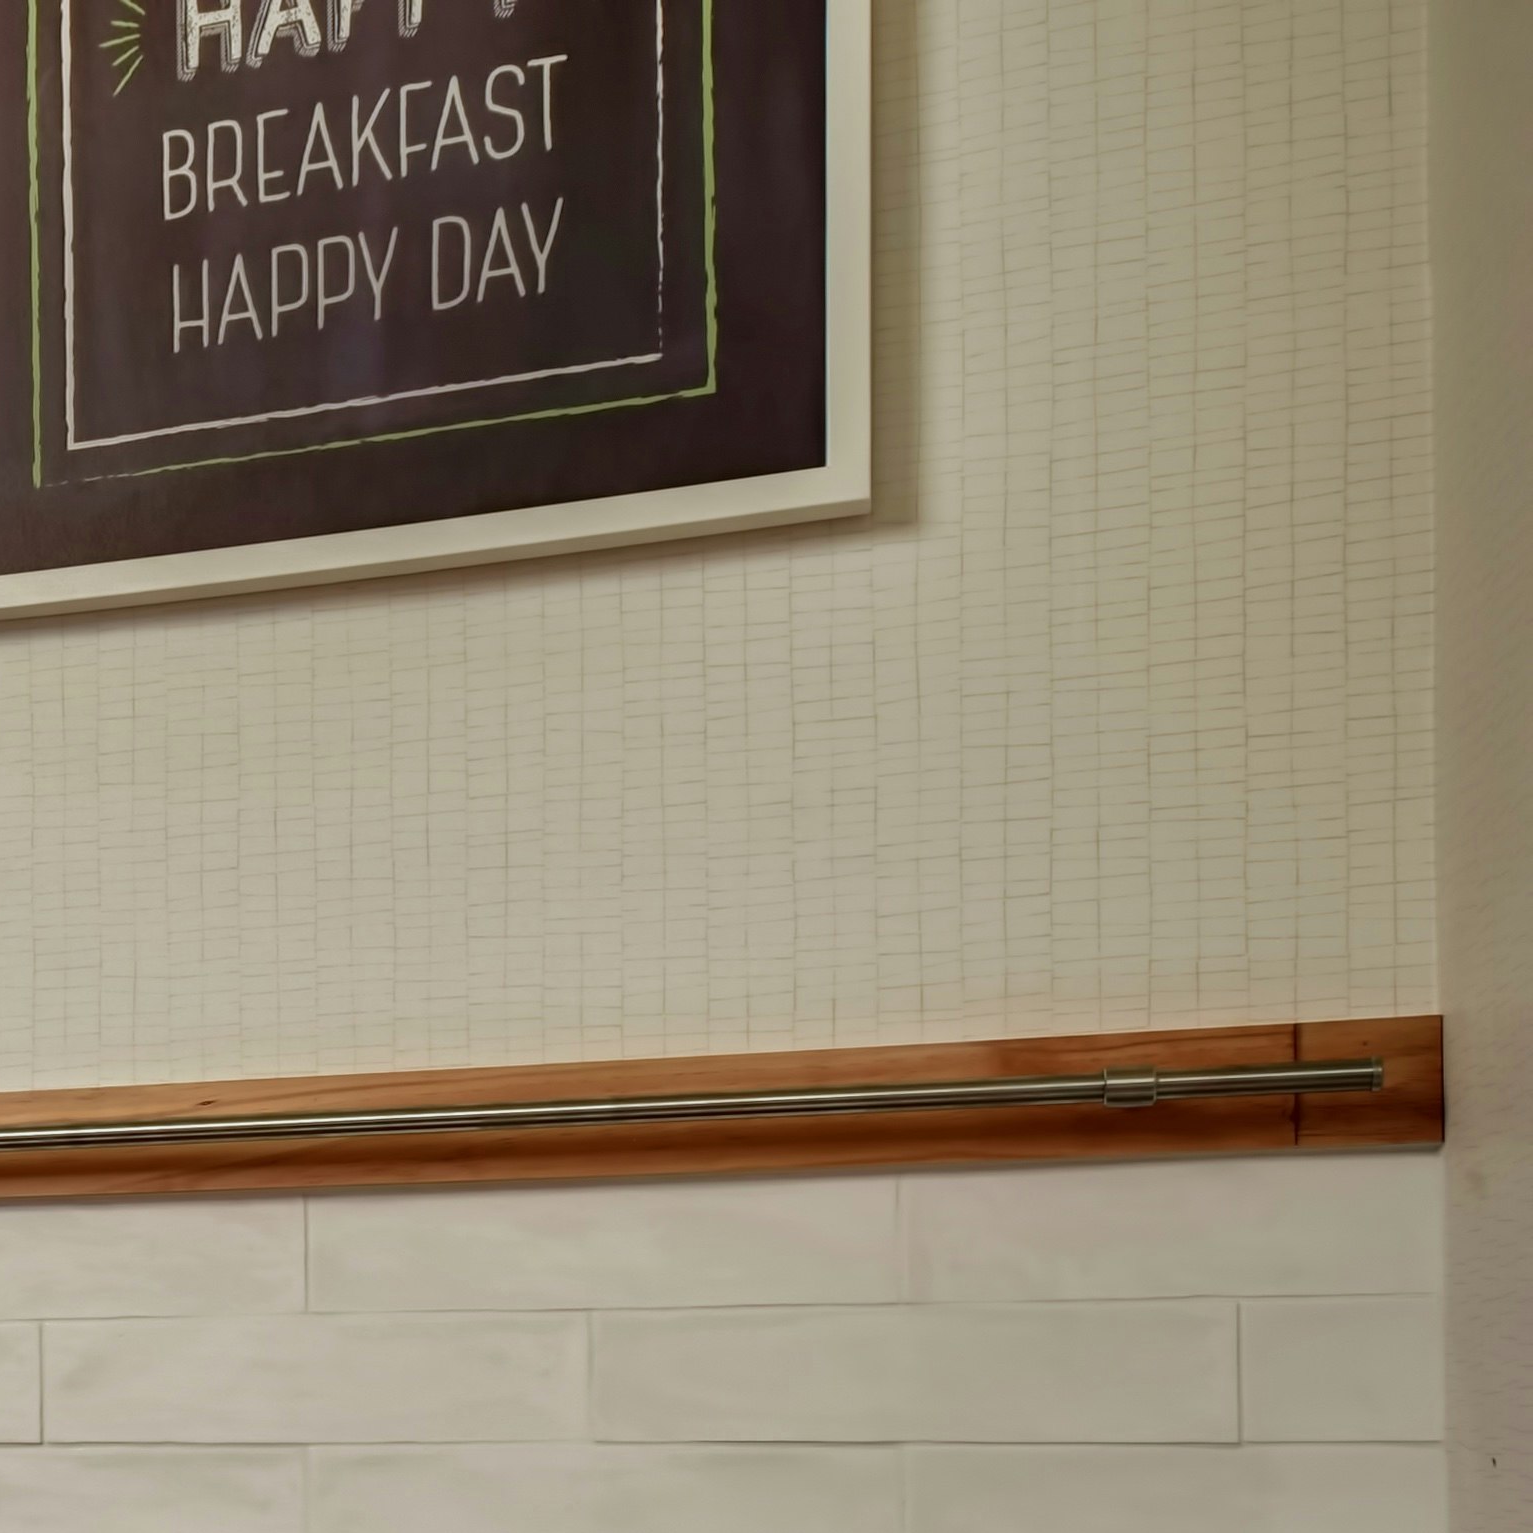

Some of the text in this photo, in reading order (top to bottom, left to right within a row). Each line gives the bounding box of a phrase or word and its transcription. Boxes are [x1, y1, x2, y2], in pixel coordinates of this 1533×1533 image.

[161, 54, 568, 221] BREAKFAST
[172, 197, 564, 354] HAPPY DAY
